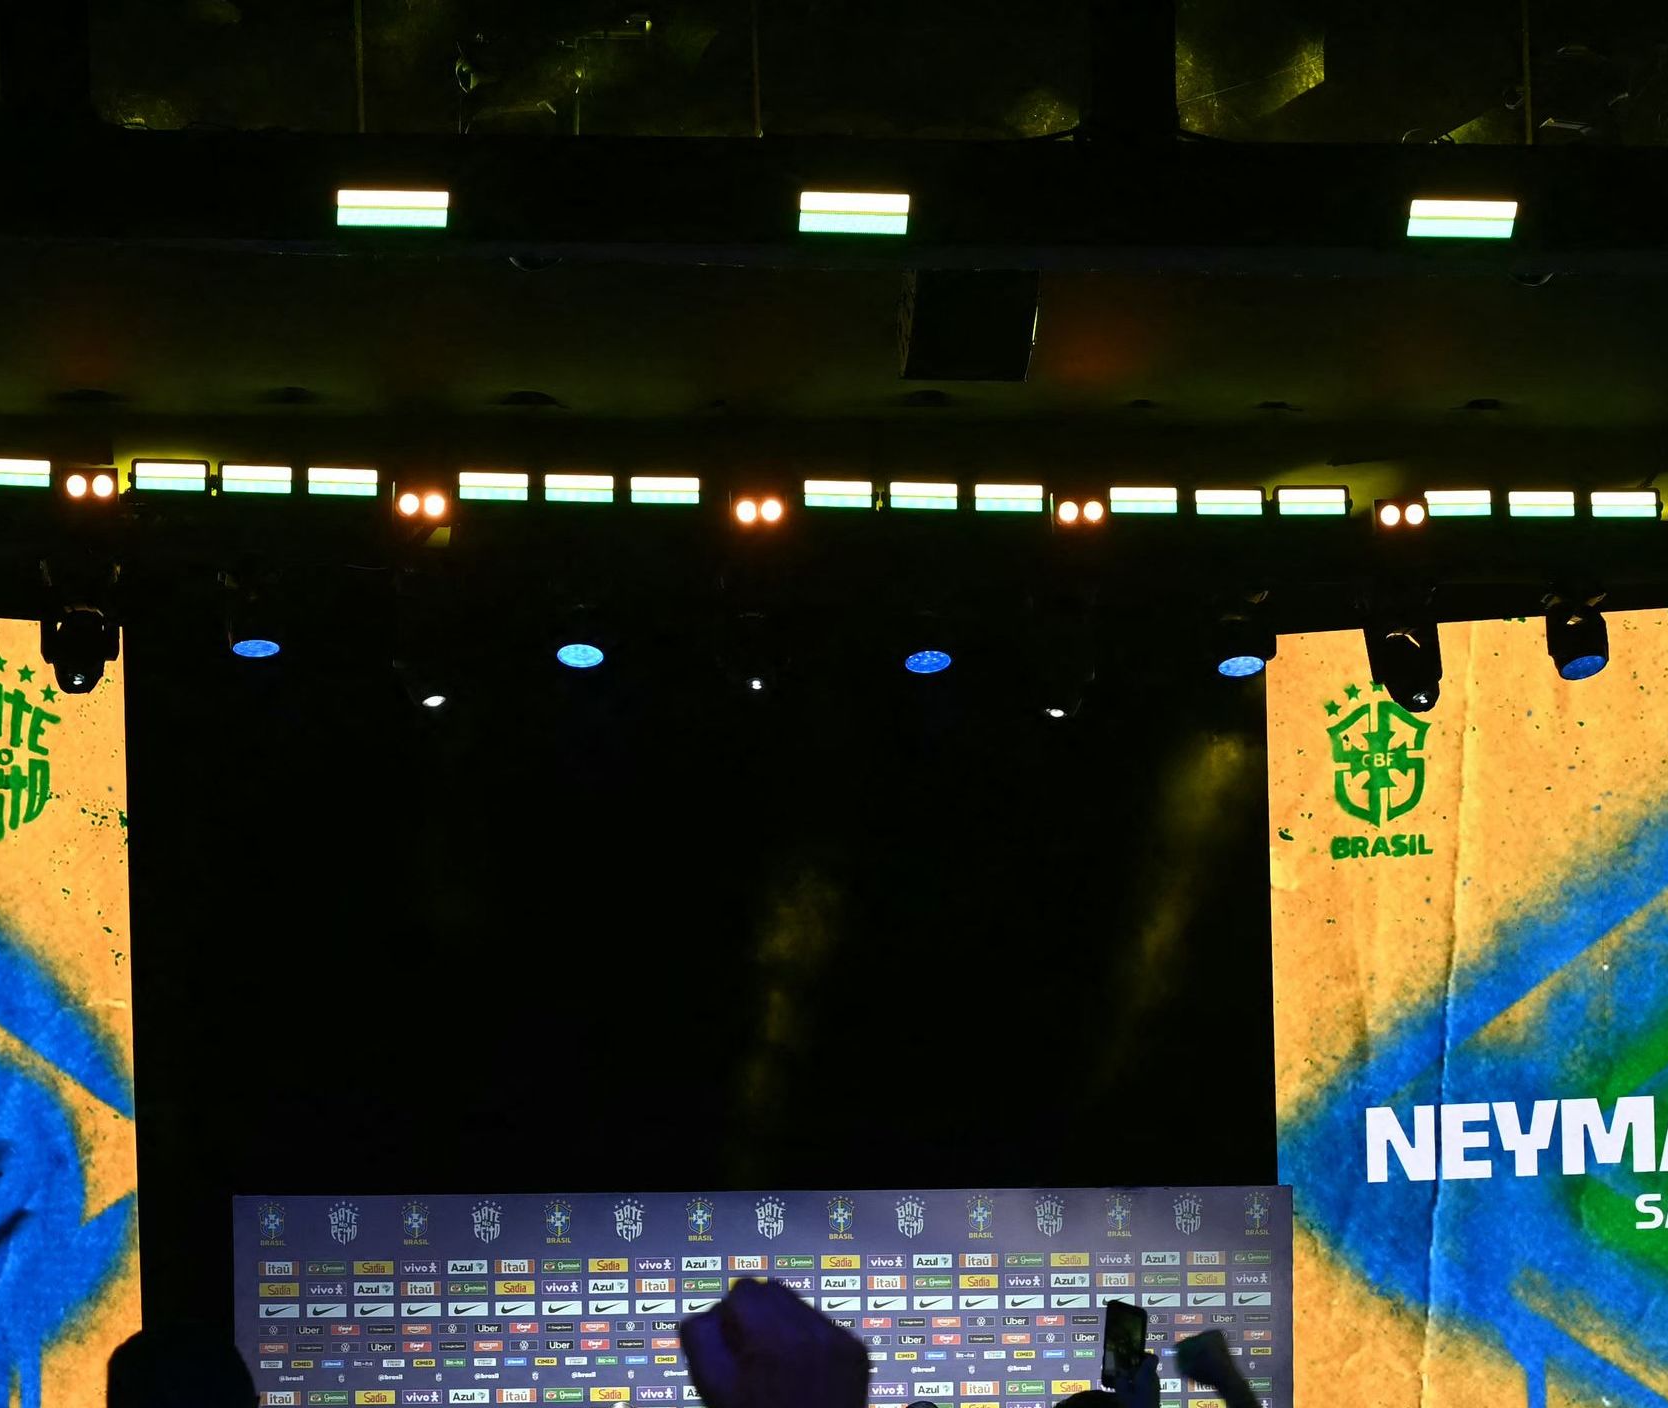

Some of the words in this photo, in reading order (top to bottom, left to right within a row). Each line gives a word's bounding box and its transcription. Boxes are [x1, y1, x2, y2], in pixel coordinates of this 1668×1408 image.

[1362, 753, 1395, 767] CBF
[1329, 834, 1433, 860] BRASIL
[755, 1203, 786, 1220] BATE
[896, 1201, 926, 1217] BATE
[1034, 1200, 1065, 1216] BATE
[1173, 1198, 1203, 1215] BATE
[329, 1209, 360, 1226] BATE
[472, 1206, 503, 1223] BATE
[614, 1206, 645, 1222] BATE
[758, 1219, 783, 1240] PEITO
[898, 1217, 924, 1238] PEITO
[1037, 1216, 1063, 1237] PEITO
[1175, 1216, 1200, 1236] PEITO
[331, 1225, 357, 1245] PEITO
[474, 1223, 500, 1244] PEITO
[616, 1222, 642, 1242] PEITO
[829, 1257, 852, 1267] Sadia
[870, 1258, 894, 1267] vivo
[917, 1257, 938, 1266] Azul
[968, 1255, 989, 1266] itaú
[1060, 1254, 1082, 1264] Sadia
[1099, 1255, 1122, 1263] vivo
[1145, 1254, 1166, 1263] Azul
[1196, 1252, 1216, 1263] itaú
[268, 1262, 290, 1274] itaú
[362, 1263, 386, 1273] Sadia
[404, 1263, 427, 1272] vivo
[451, 1262, 473, 1272] Azul
[503, 1262, 525, 1272] itaú
[597, 1260, 620, 1270] Sadia
[639, 1261, 662, 1270] vivo
[685, 1260, 707, 1269] Azul
[737, 1259, 759, 1269] itaú
[825, 1277, 847, 1287] Azul
[876, 1277, 897, 1287] itaú
[968, 1277, 990, 1287] Sadia
[1009, 1277, 1031, 1286] vivo
[1054, 1276, 1075, 1285] Azul
[1105, 1275, 1126, 1285] itaú
[1196, 1274, 1217, 1284] Sadia
[1236, 1274, 1259, 1283] vivo
[268, 1285, 291, 1295] Sadia
[311, 1285, 333, 1294] vivo
[357, 1284, 380, 1294] Azul
[410, 1283, 432, 1294] itaú
[503, 1283, 526, 1293] Sadia
[546, 1283, 569, 1292] vivo
[592, 1282, 614, 1292] Azul
[645, 1281, 666, 1291] itaú
[655, 1322, 676, 1330] Uber
[1005, 1317, 1026, 1325] Uber
[299, 1325, 319, 1334] Uber
[478, 1324, 498, 1332] Uber
[901, 1336, 922, 1344] Uber
[1075, 1333, 1095, 1342] Uber
[371, 1342, 392, 1351] Uber
[549, 1341, 570, 1349] Uber
[872, 1386, 895, 1395] vivo
[918, 1385, 939, 1394] Azul
[969, 1383, 990, 1394] itaú
[1060, 1382, 1083, 1392] Sadia
[269, 1393, 292, 1404] itaú
[364, 1392, 387, 1403] Sadia
[405, 1393, 429, 1402] vivo
[453, 1392, 474, 1401] Azul
[505, 1391, 527, 1401] itaú
[599, 1389, 621, 1400] Sadia
[641, 1390, 664, 1399] vivo
